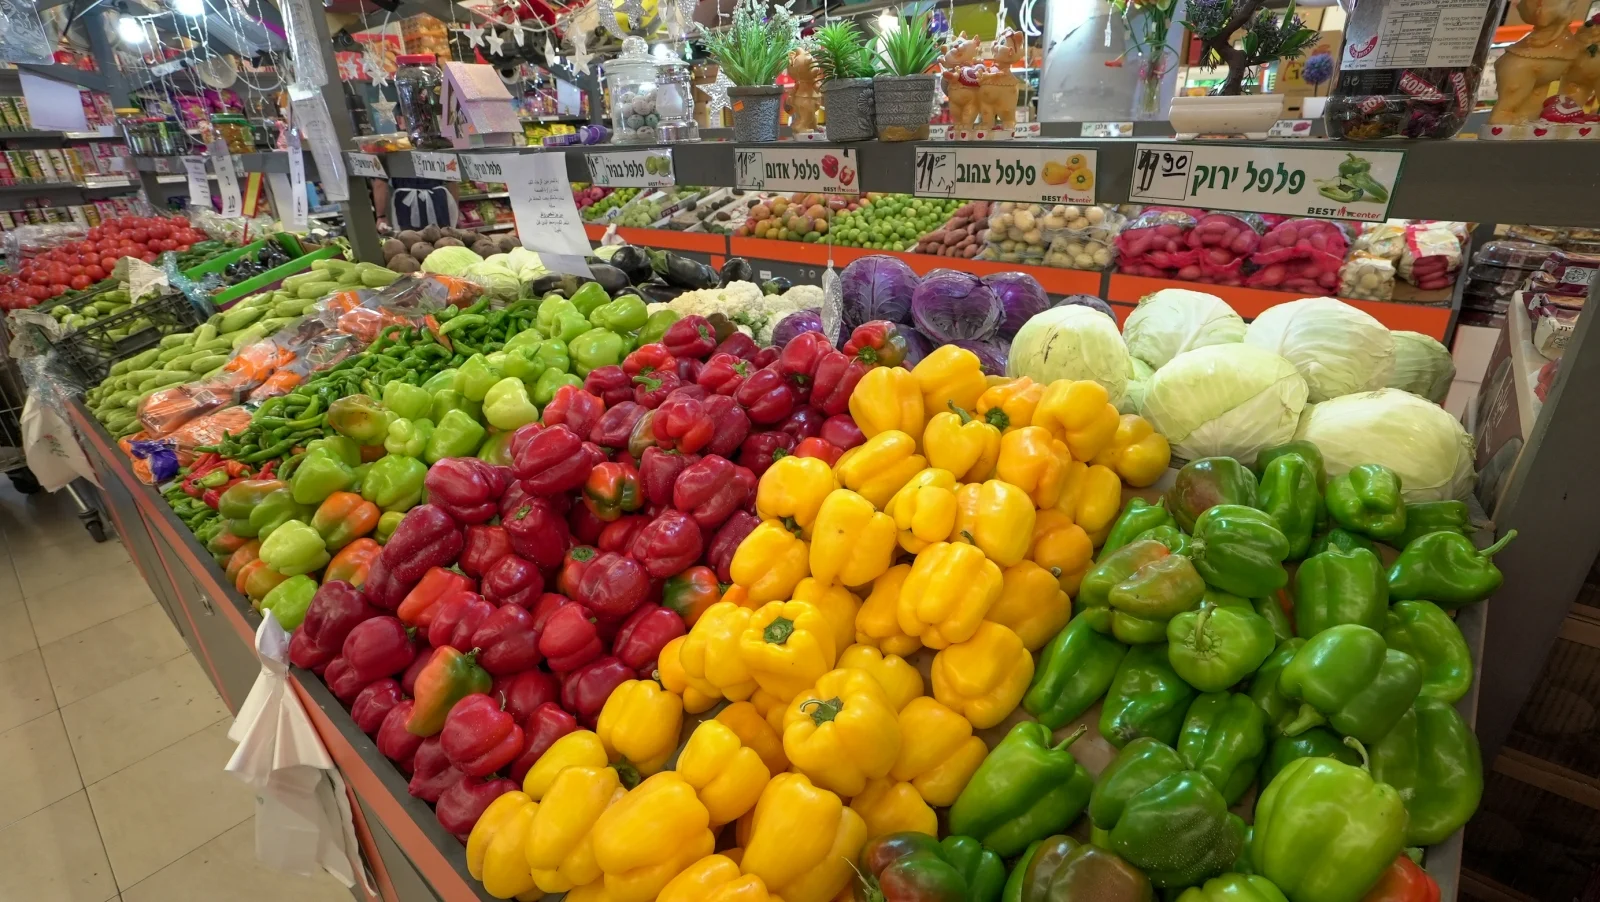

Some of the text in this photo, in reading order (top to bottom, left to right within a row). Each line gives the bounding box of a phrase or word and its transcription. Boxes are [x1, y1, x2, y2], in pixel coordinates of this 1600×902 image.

[485, 161, 502, 175] פלפל
[606, 160, 644, 178] פלפל בהיר
[766, 158, 820, 180] פלפל אדום
[956, 159, 1036, 186] פלפל צהוב
[1162, 153, 1187, 173] 90
[1190, 160, 1306, 196] פלפל ירוק
[1307, 206, 1382, 219] BEST center
